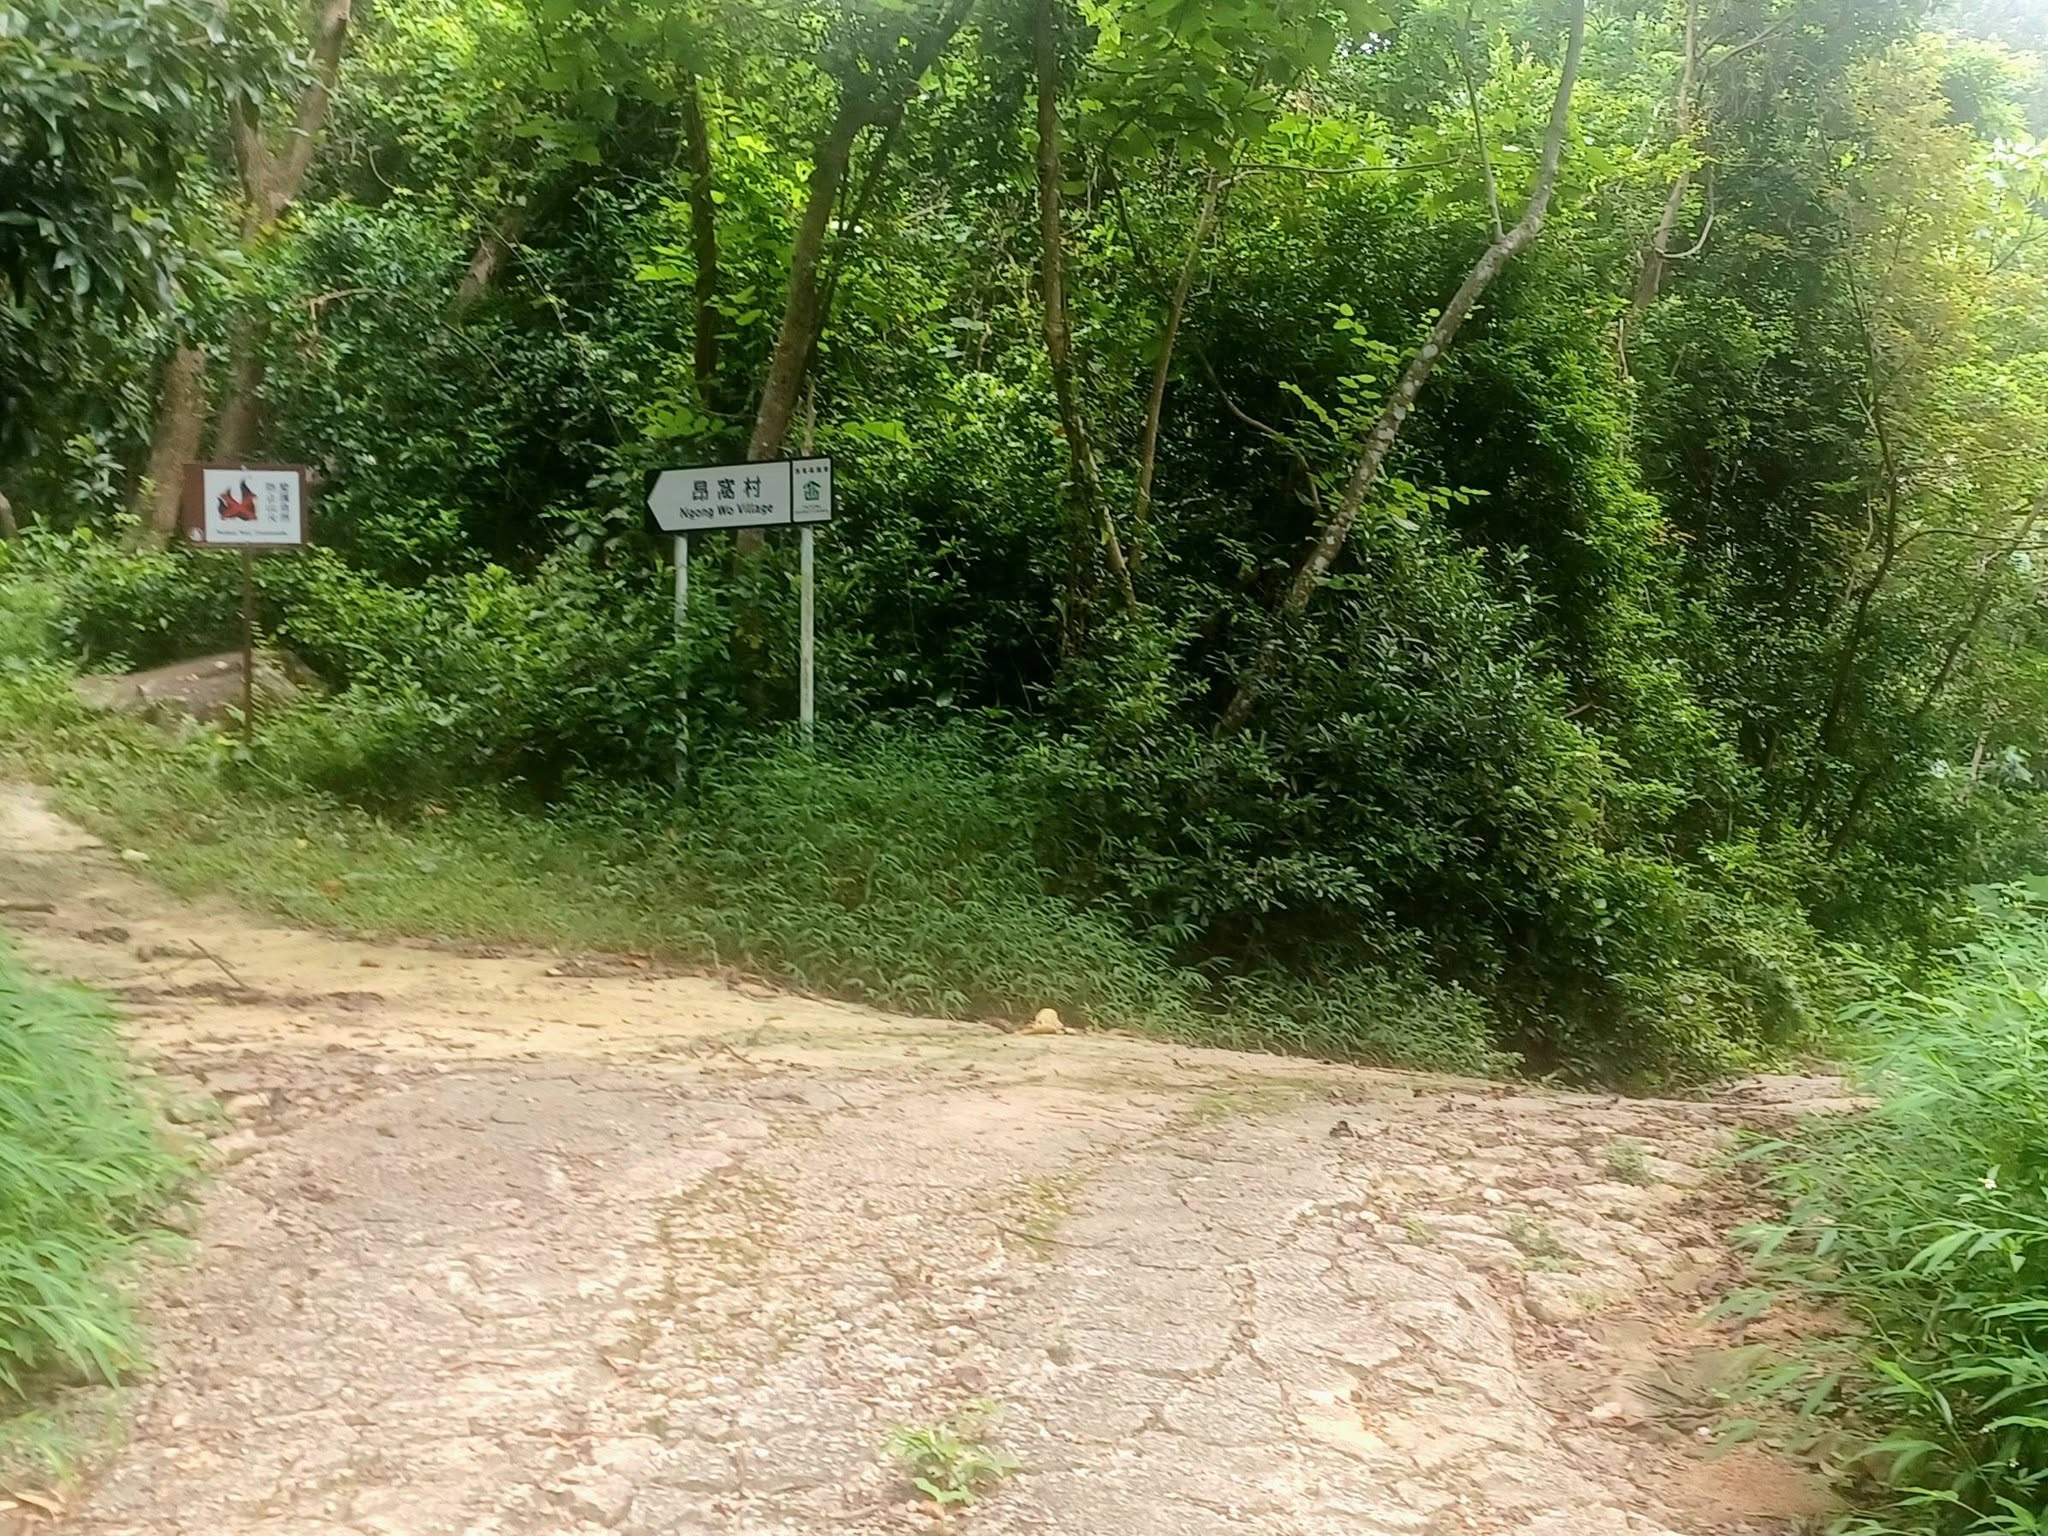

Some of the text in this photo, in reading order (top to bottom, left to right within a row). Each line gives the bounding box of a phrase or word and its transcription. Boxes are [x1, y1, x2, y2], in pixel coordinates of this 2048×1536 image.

[680, 503, 774, 520] Ngong Wo Village
